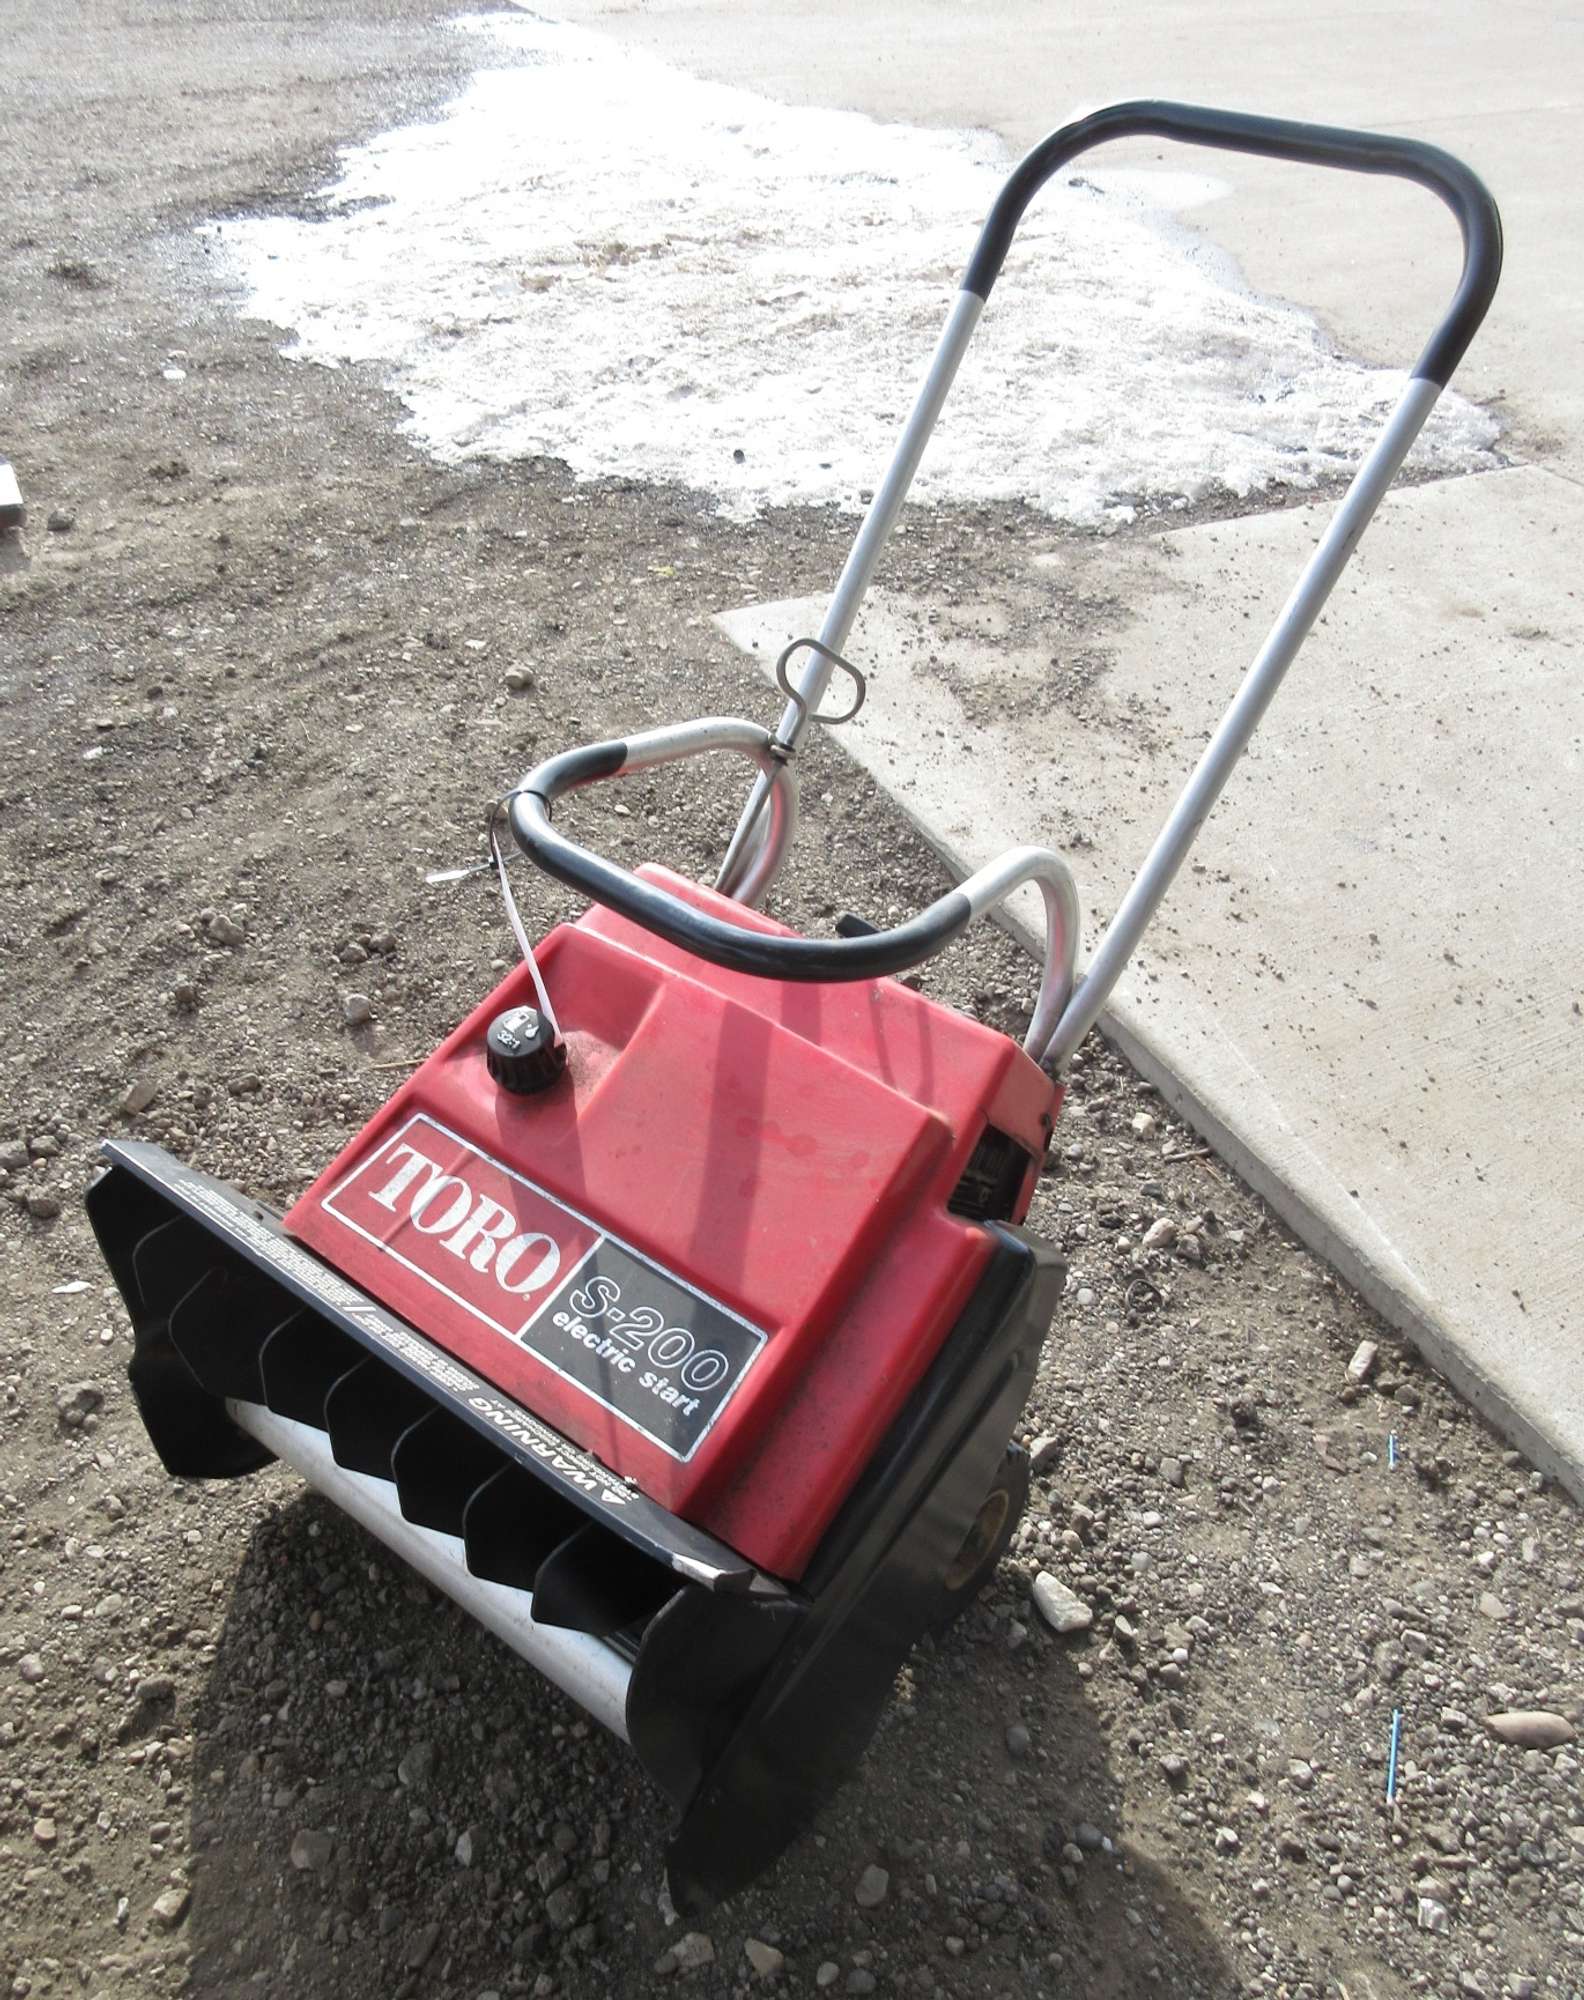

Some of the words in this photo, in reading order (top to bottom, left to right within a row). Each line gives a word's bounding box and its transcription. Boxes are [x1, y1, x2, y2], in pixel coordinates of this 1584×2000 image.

[496, 1030, 521, 1049] 32:1
[368, 1143, 561, 1294] TORO
[552, 1311, 636, 1373] electric
[638, 1371, 701, 1416] start
[569, 1276, 729, 1391] S-200
[469, 1397, 598, 1491] WARNING
